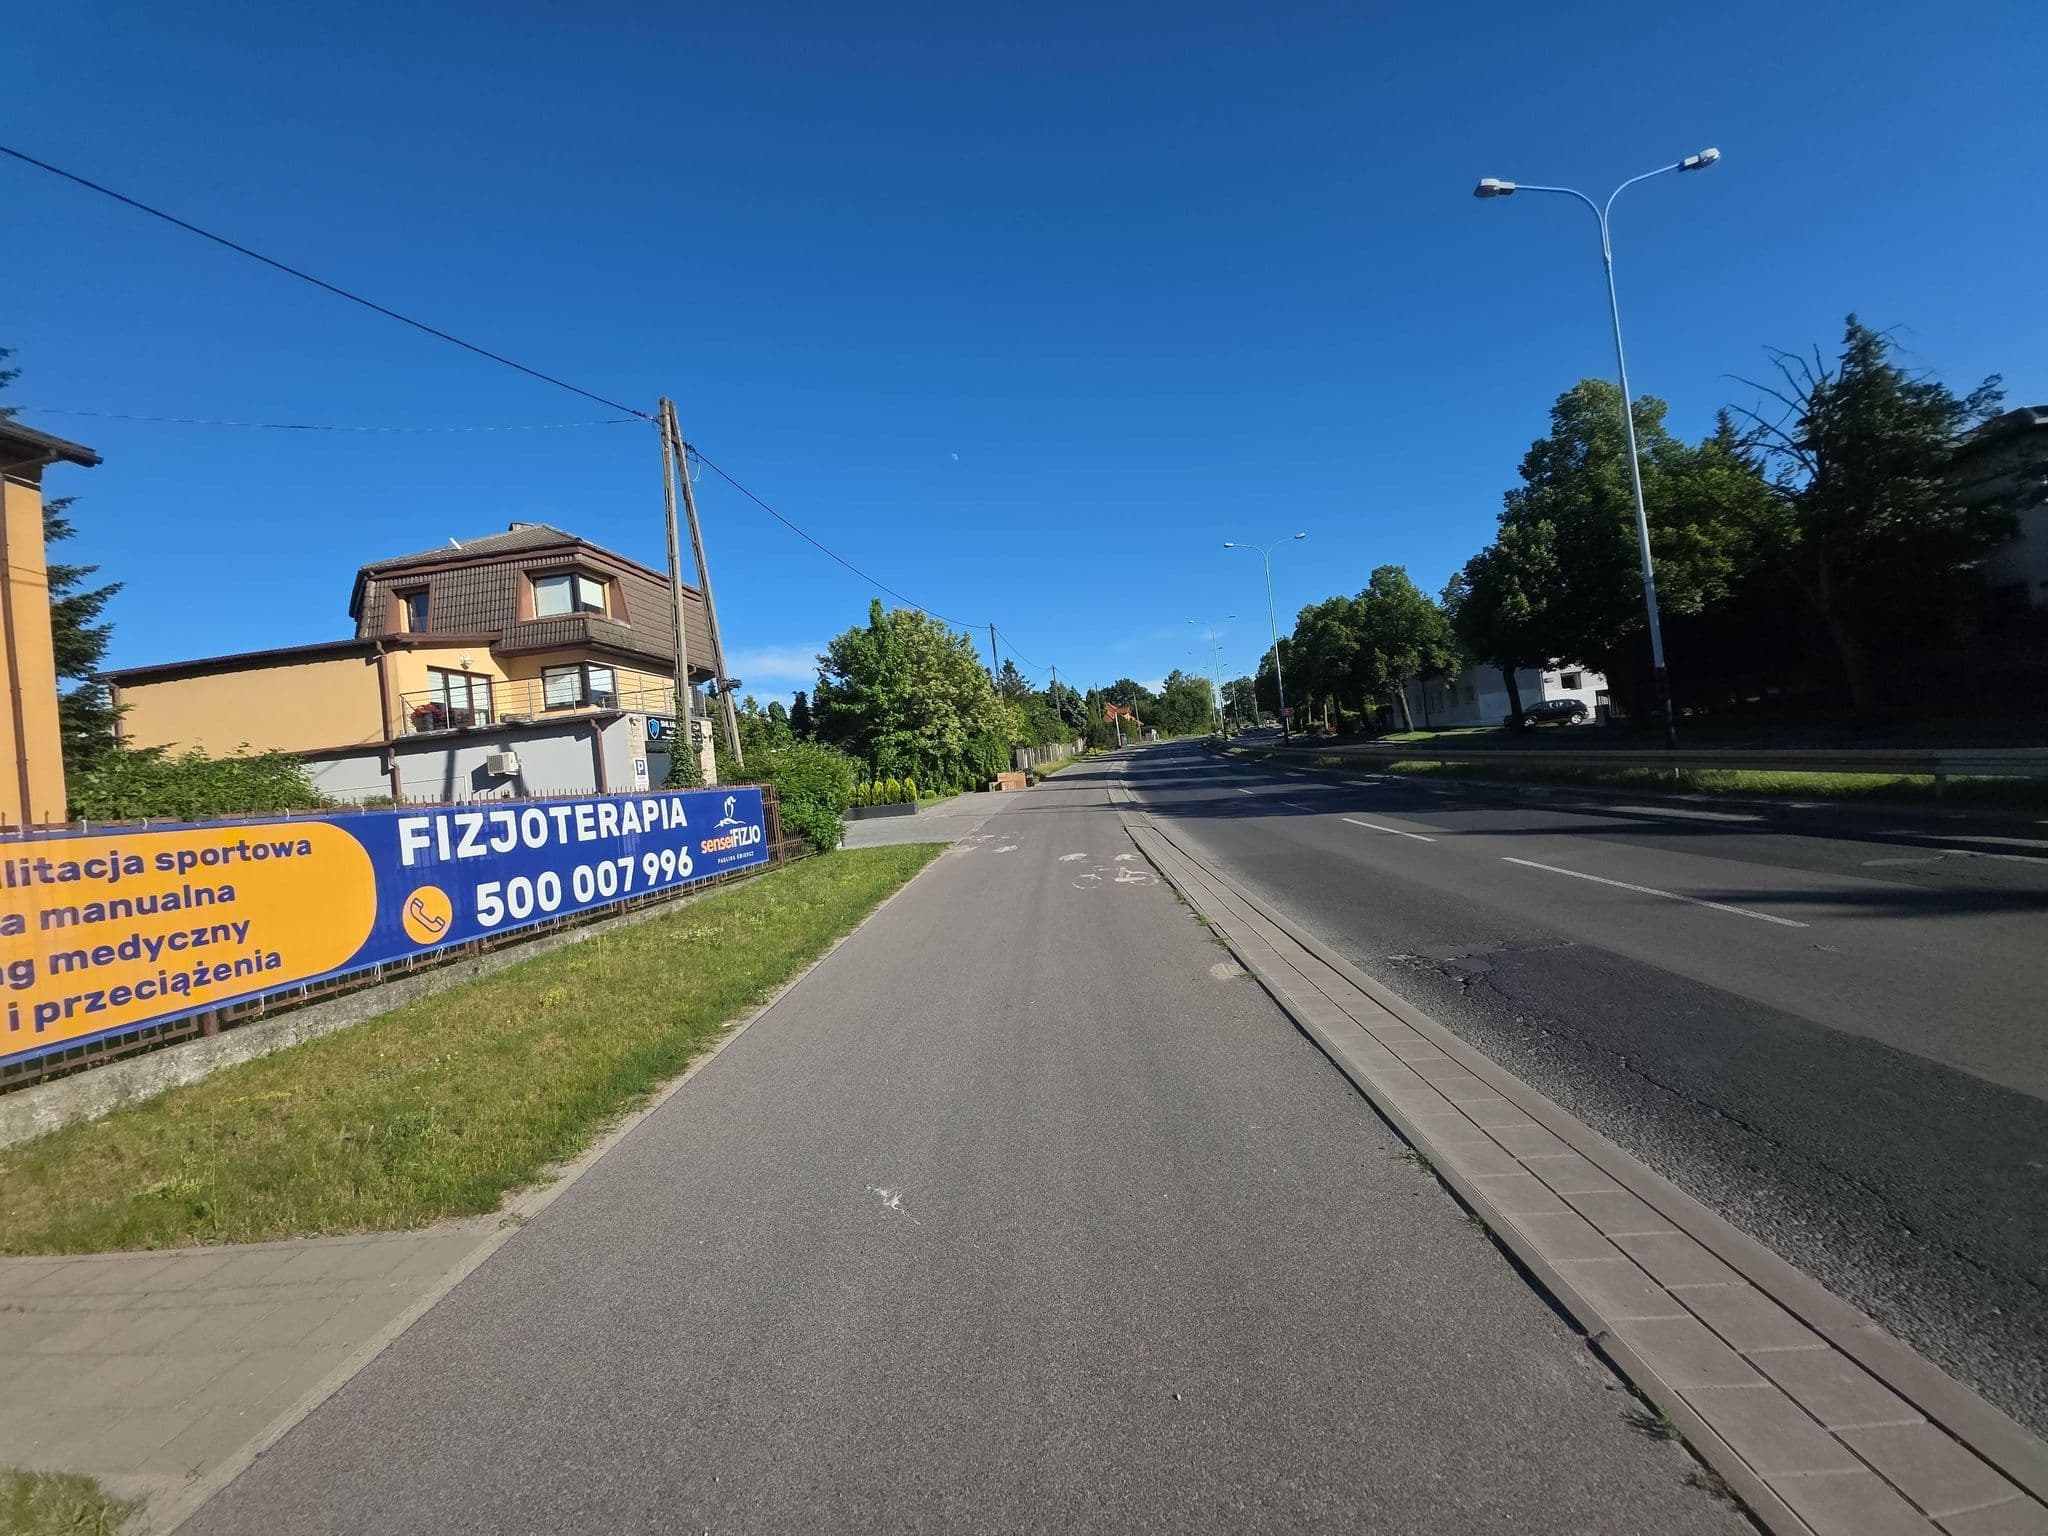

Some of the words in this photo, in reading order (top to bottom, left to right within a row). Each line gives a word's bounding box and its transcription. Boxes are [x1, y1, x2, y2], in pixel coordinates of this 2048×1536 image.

[0, 850, 145, 889] litacja
[155, 839, 312, 875] sportowa
[398, 797, 688, 866] FIZJOTERAPIA
[40, 882, 236, 931] manualna
[476, 871, 562, 927] 500
[572, 856, 635, 903] 007
[642, 846, 694, 887] 996
[0, 958, 36, 990] g
[50, 919, 251, 975] medyczny
[8, 1001, 20, 1032] i
[34, 949, 282, 1033] przeciążenia
